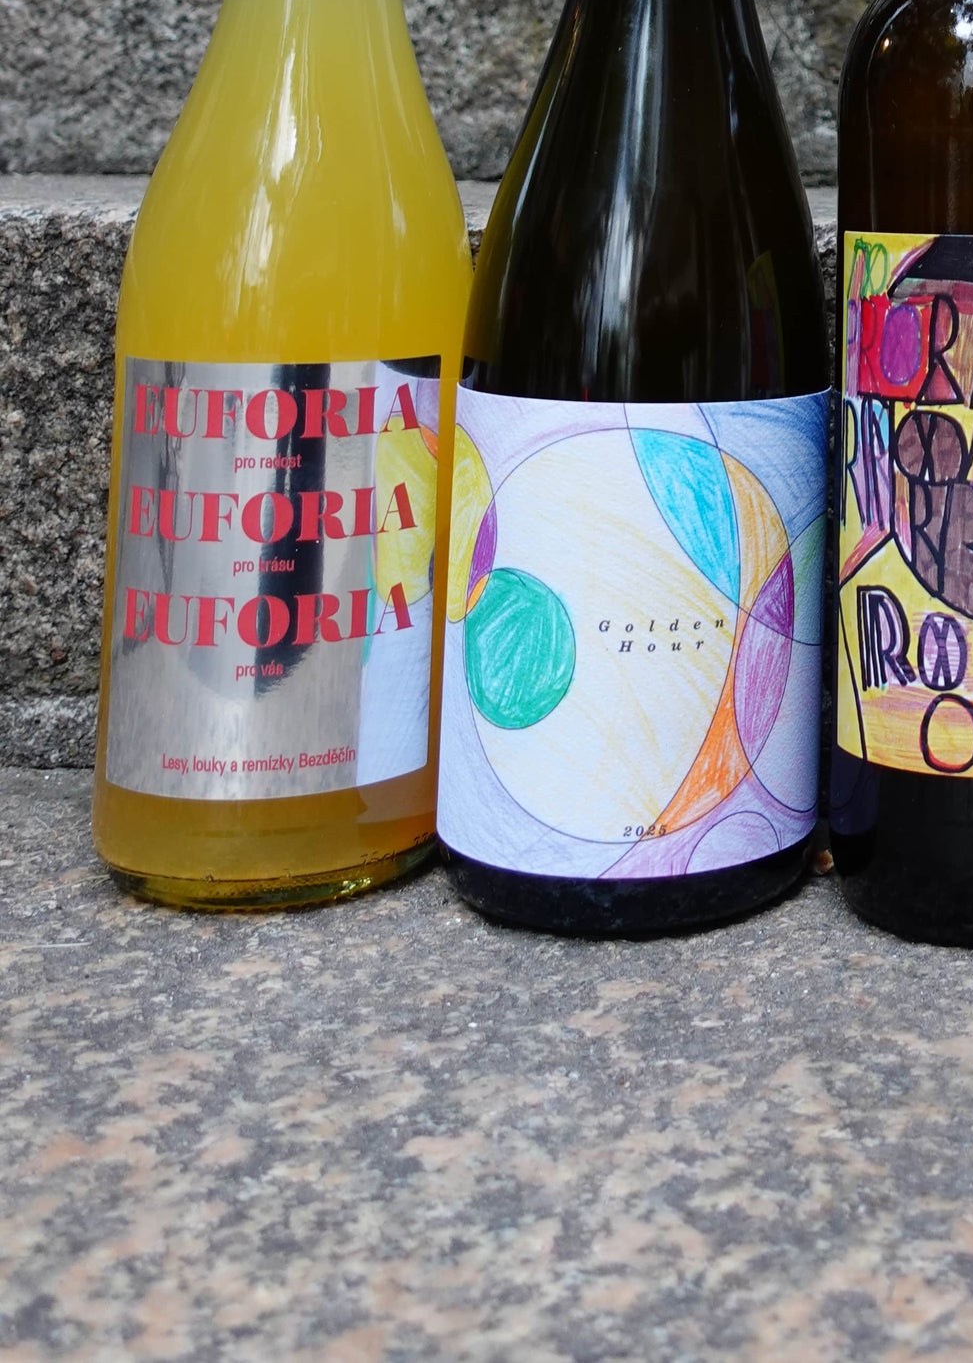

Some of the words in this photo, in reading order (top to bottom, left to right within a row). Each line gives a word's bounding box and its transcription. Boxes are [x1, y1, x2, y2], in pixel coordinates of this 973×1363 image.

[134, 382, 421, 440] EUFORIA
[234, 456, 256, 473] pro
[260, 453, 302, 469] radost
[128, 482, 417, 544] EUFORIA
[233, 559, 255, 576] pro
[259, 555, 295, 573] krásu
[123, 581, 414, 648] EUFORIA
[598, 618, 724, 633] Golden
[618, 640, 704, 653] Hour
[235, 663, 257, 681] pro
[260, 659, 284, 677] vás
[161, 753, 189, 775] Lesy,
[193, 755, 226, 777] louky
[230, 759, 238, 772] a
[241, 754, 295, 774] remízky
[298, 745, 356, 769] Bezděčín
